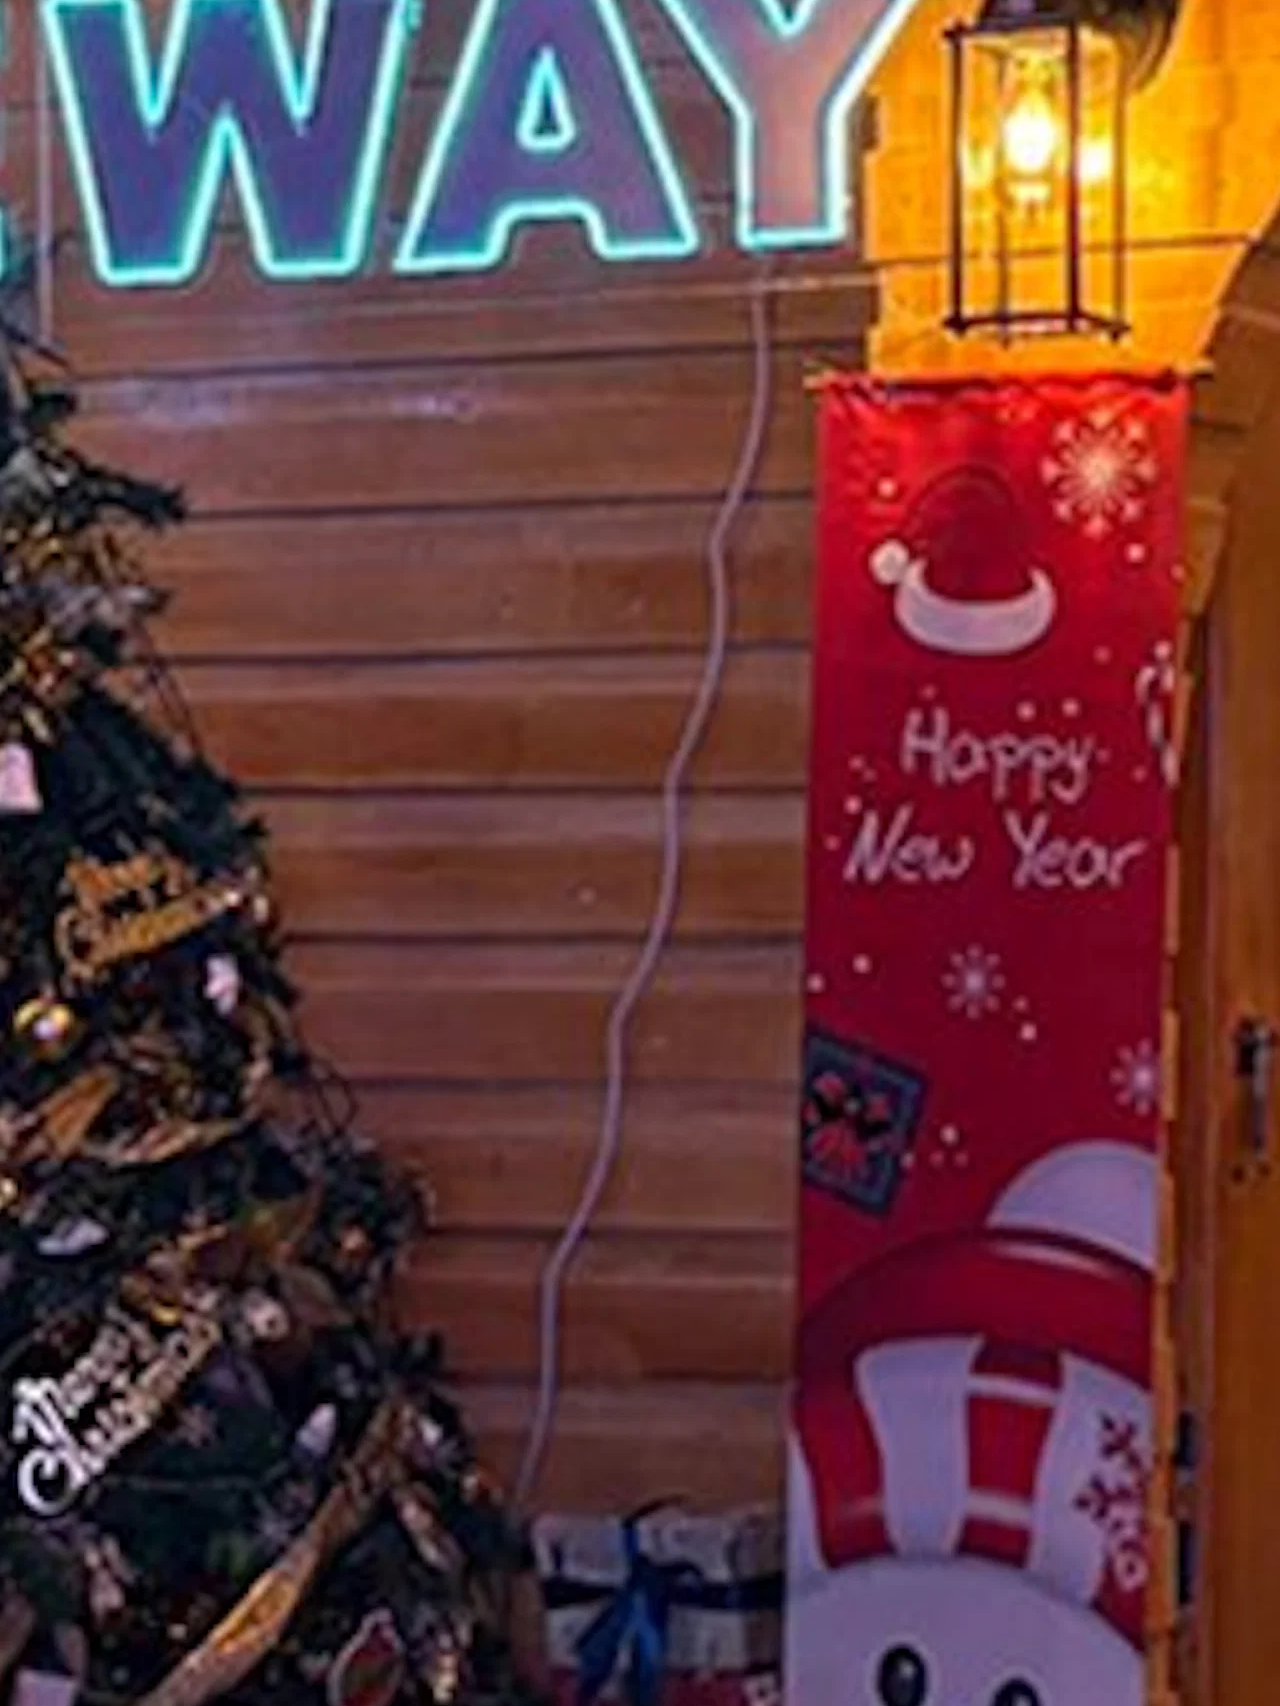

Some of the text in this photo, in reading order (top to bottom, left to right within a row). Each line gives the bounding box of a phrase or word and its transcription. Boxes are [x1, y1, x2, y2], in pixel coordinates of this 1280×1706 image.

[900, 705, 1094, 804] Happy
[843, 802, 1148, 889] New Year
